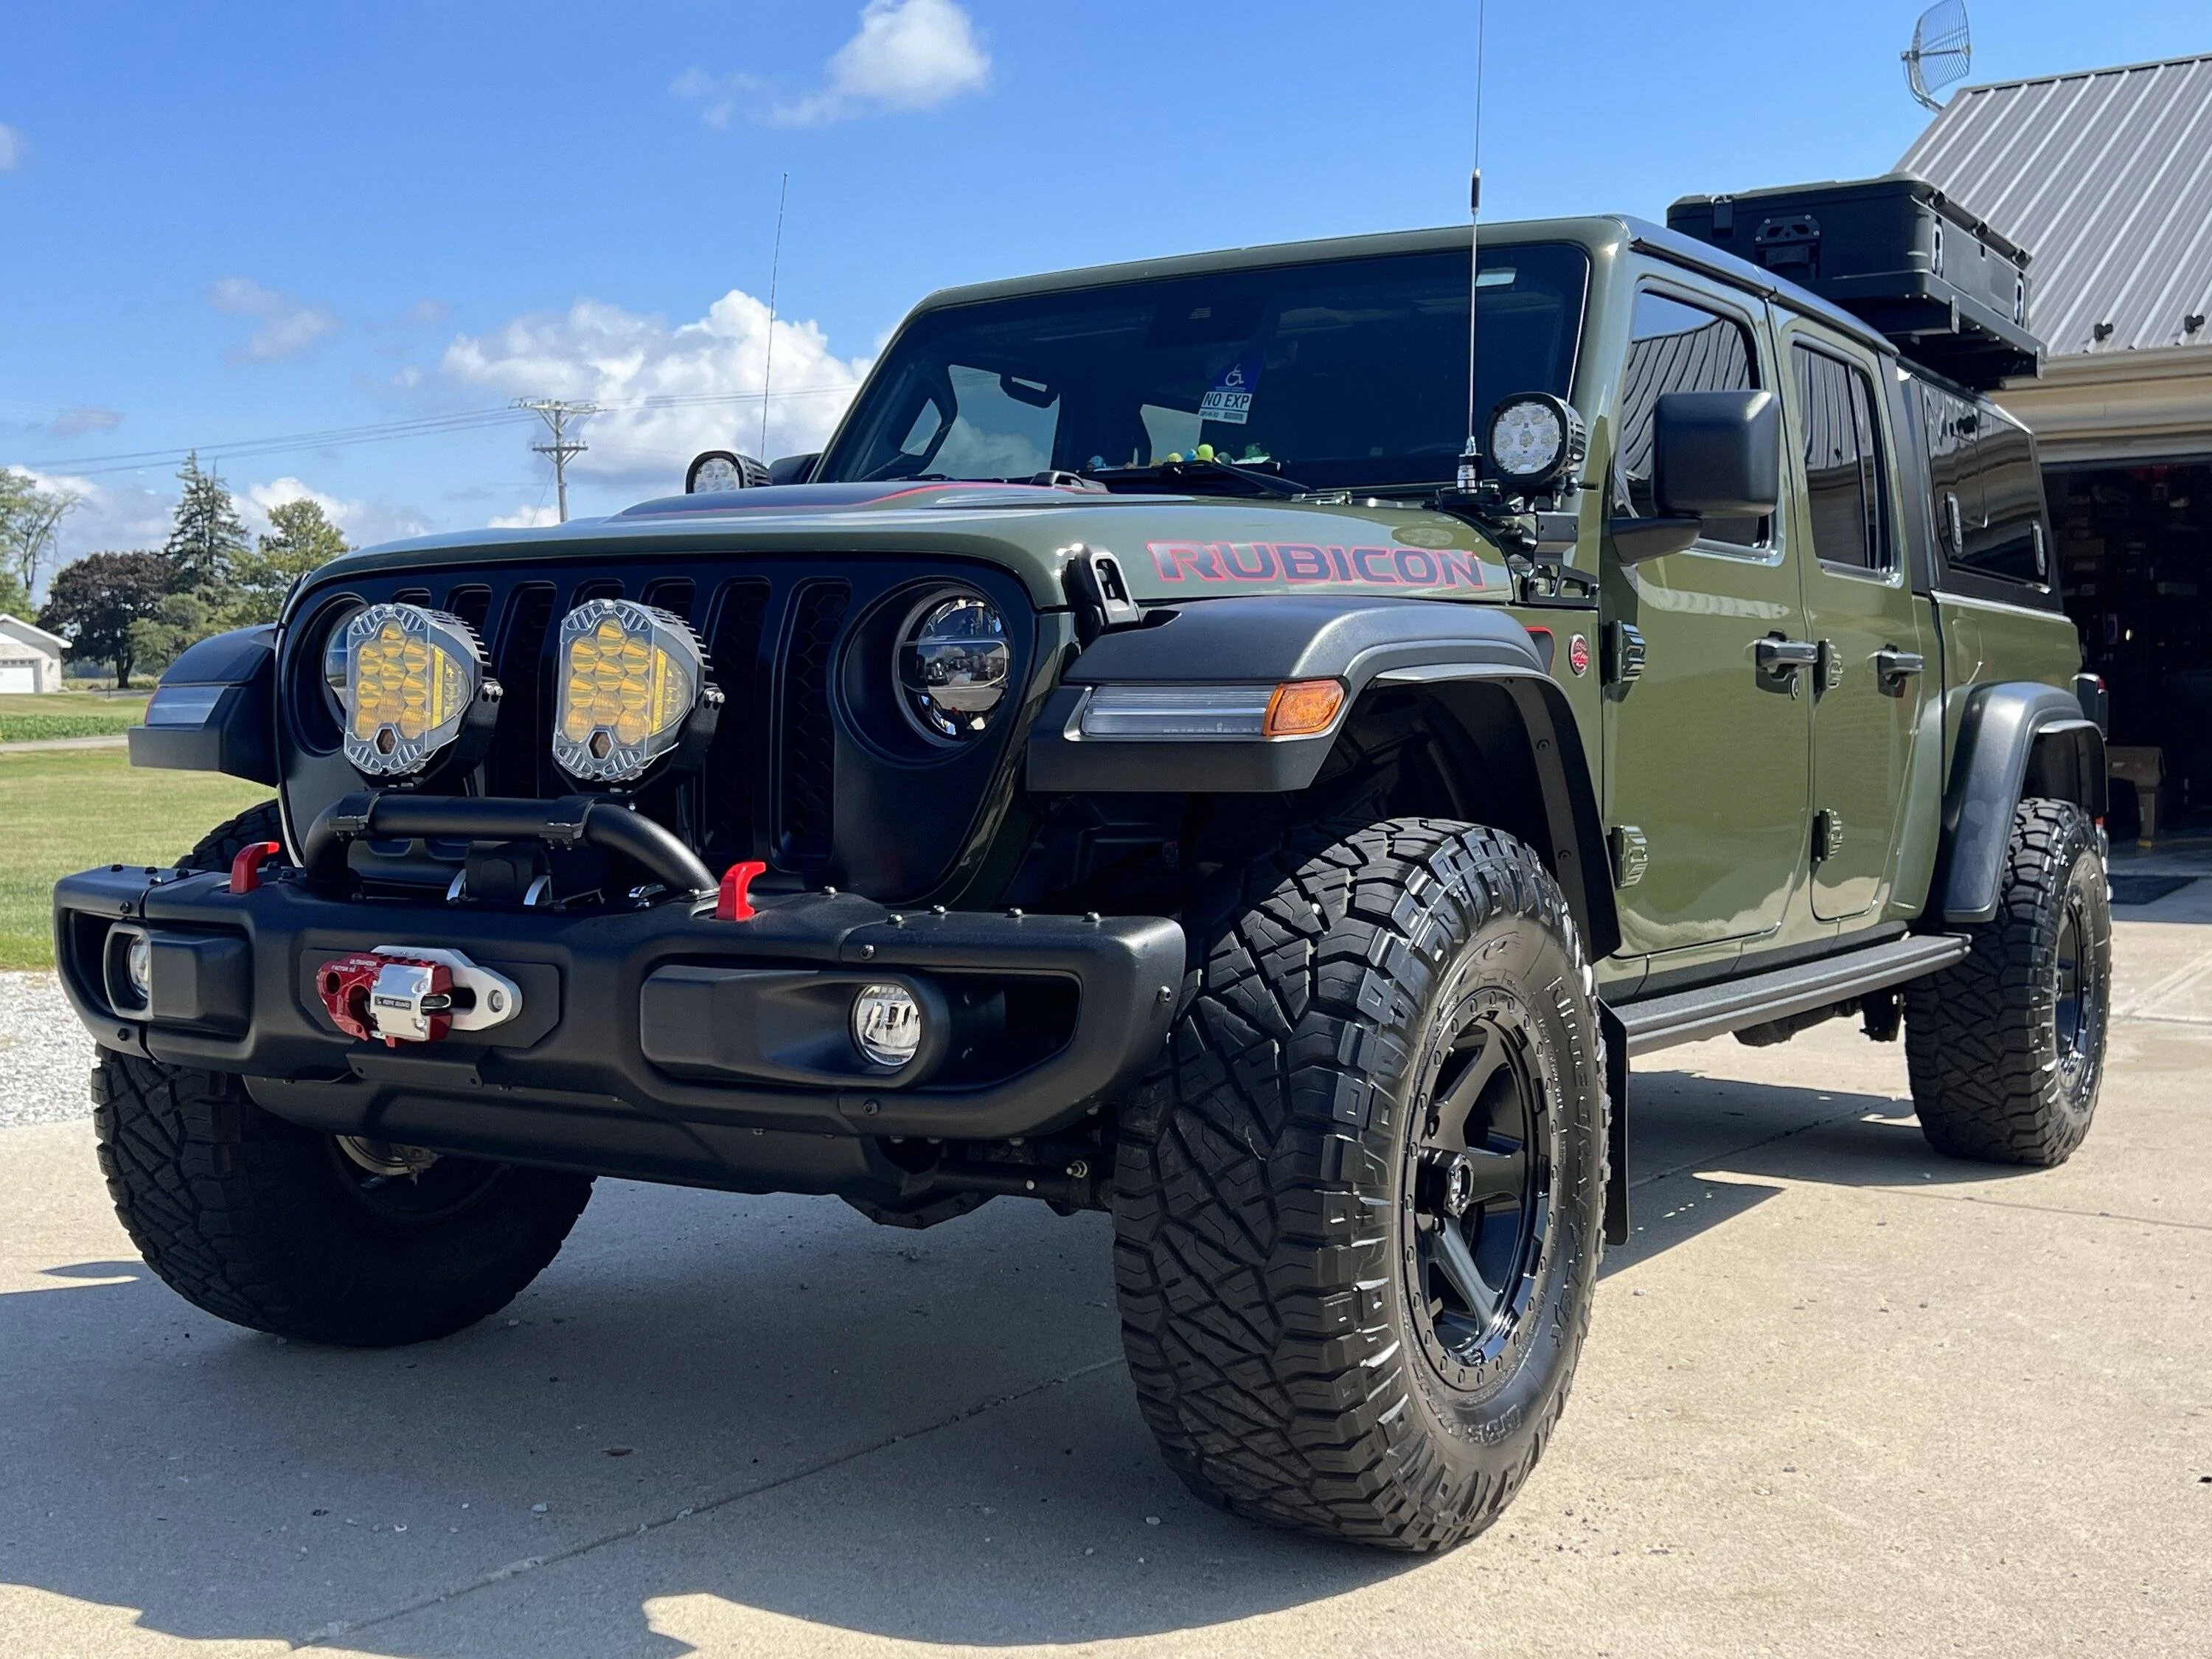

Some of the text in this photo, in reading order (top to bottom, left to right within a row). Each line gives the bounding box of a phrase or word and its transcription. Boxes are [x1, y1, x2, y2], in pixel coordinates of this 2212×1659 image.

[1203, 393, 1250, 409] NO EXP
[1144, 541, 1485, 588] RUBICON
